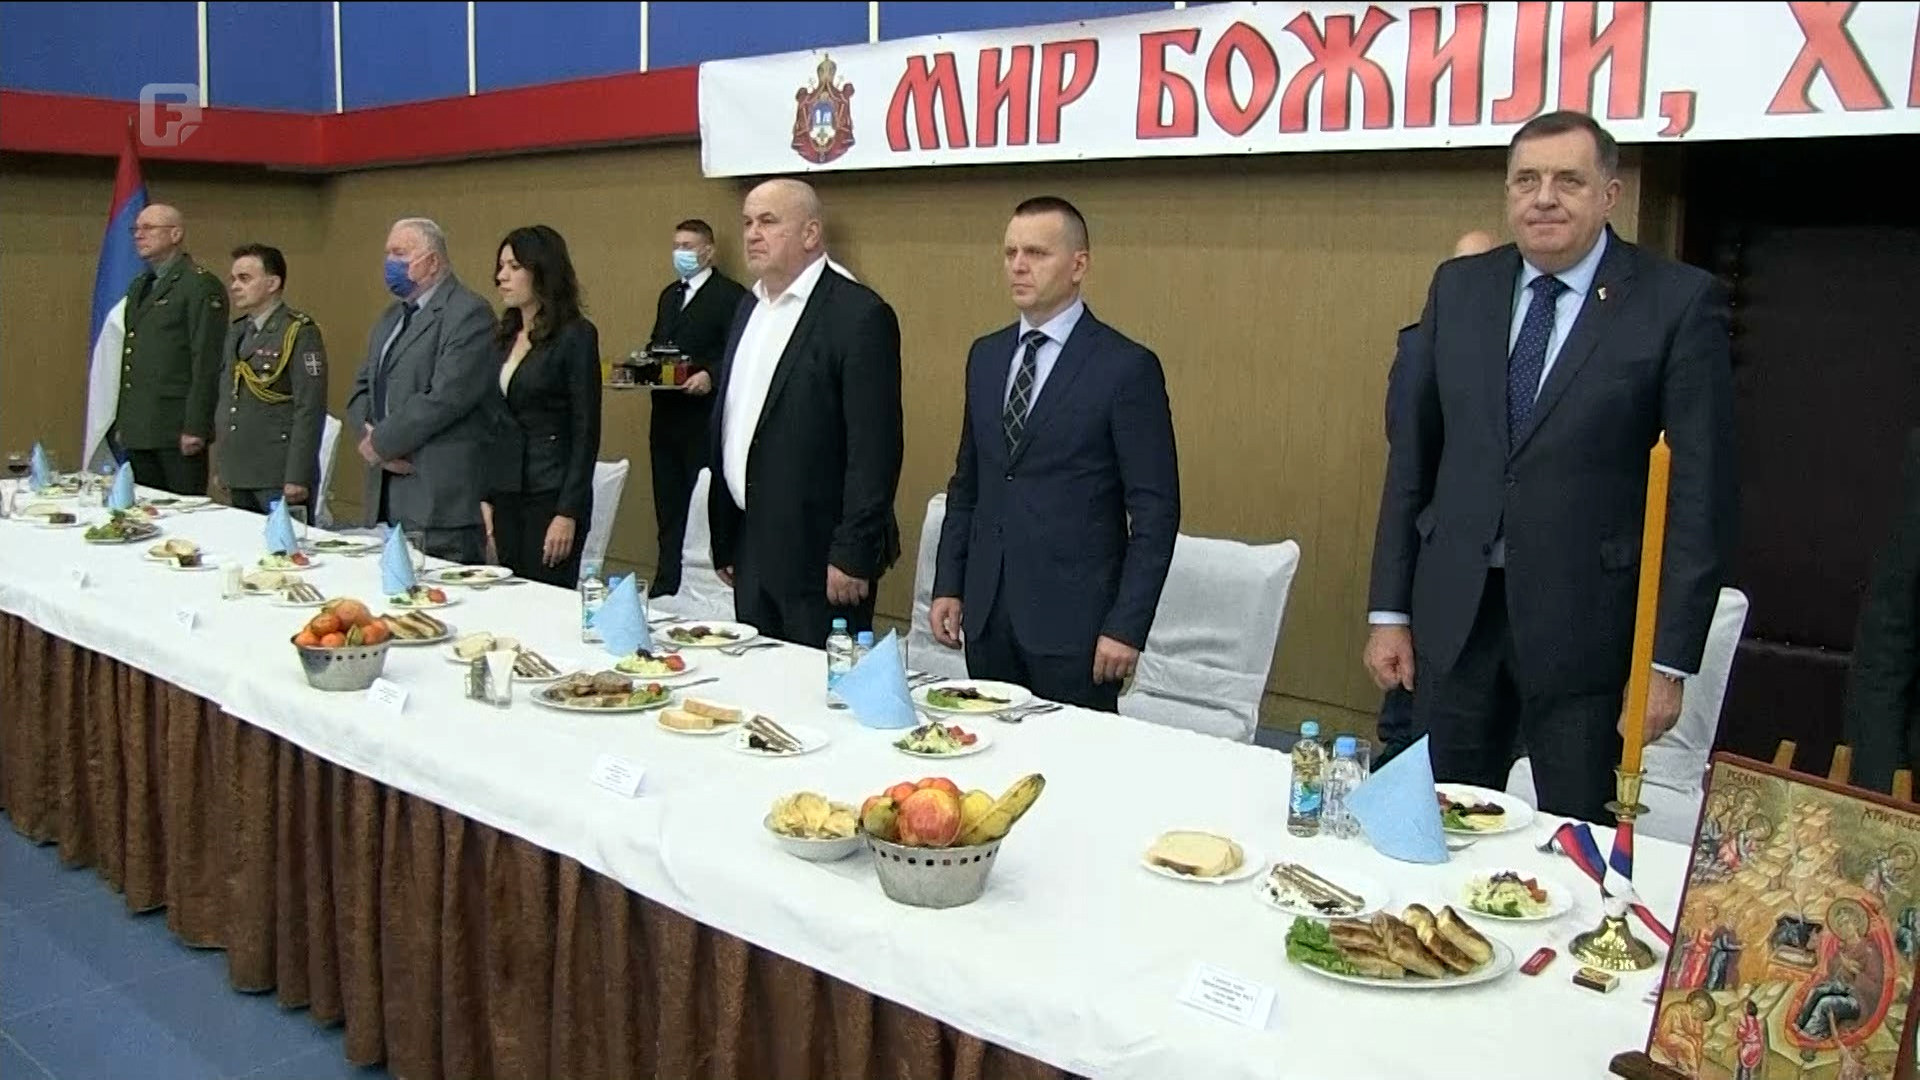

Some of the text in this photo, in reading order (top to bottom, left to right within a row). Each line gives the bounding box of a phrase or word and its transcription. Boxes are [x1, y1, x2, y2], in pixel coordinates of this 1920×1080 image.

[885, 2, 1920, 153] МИР БОЖИЈИ, Х
